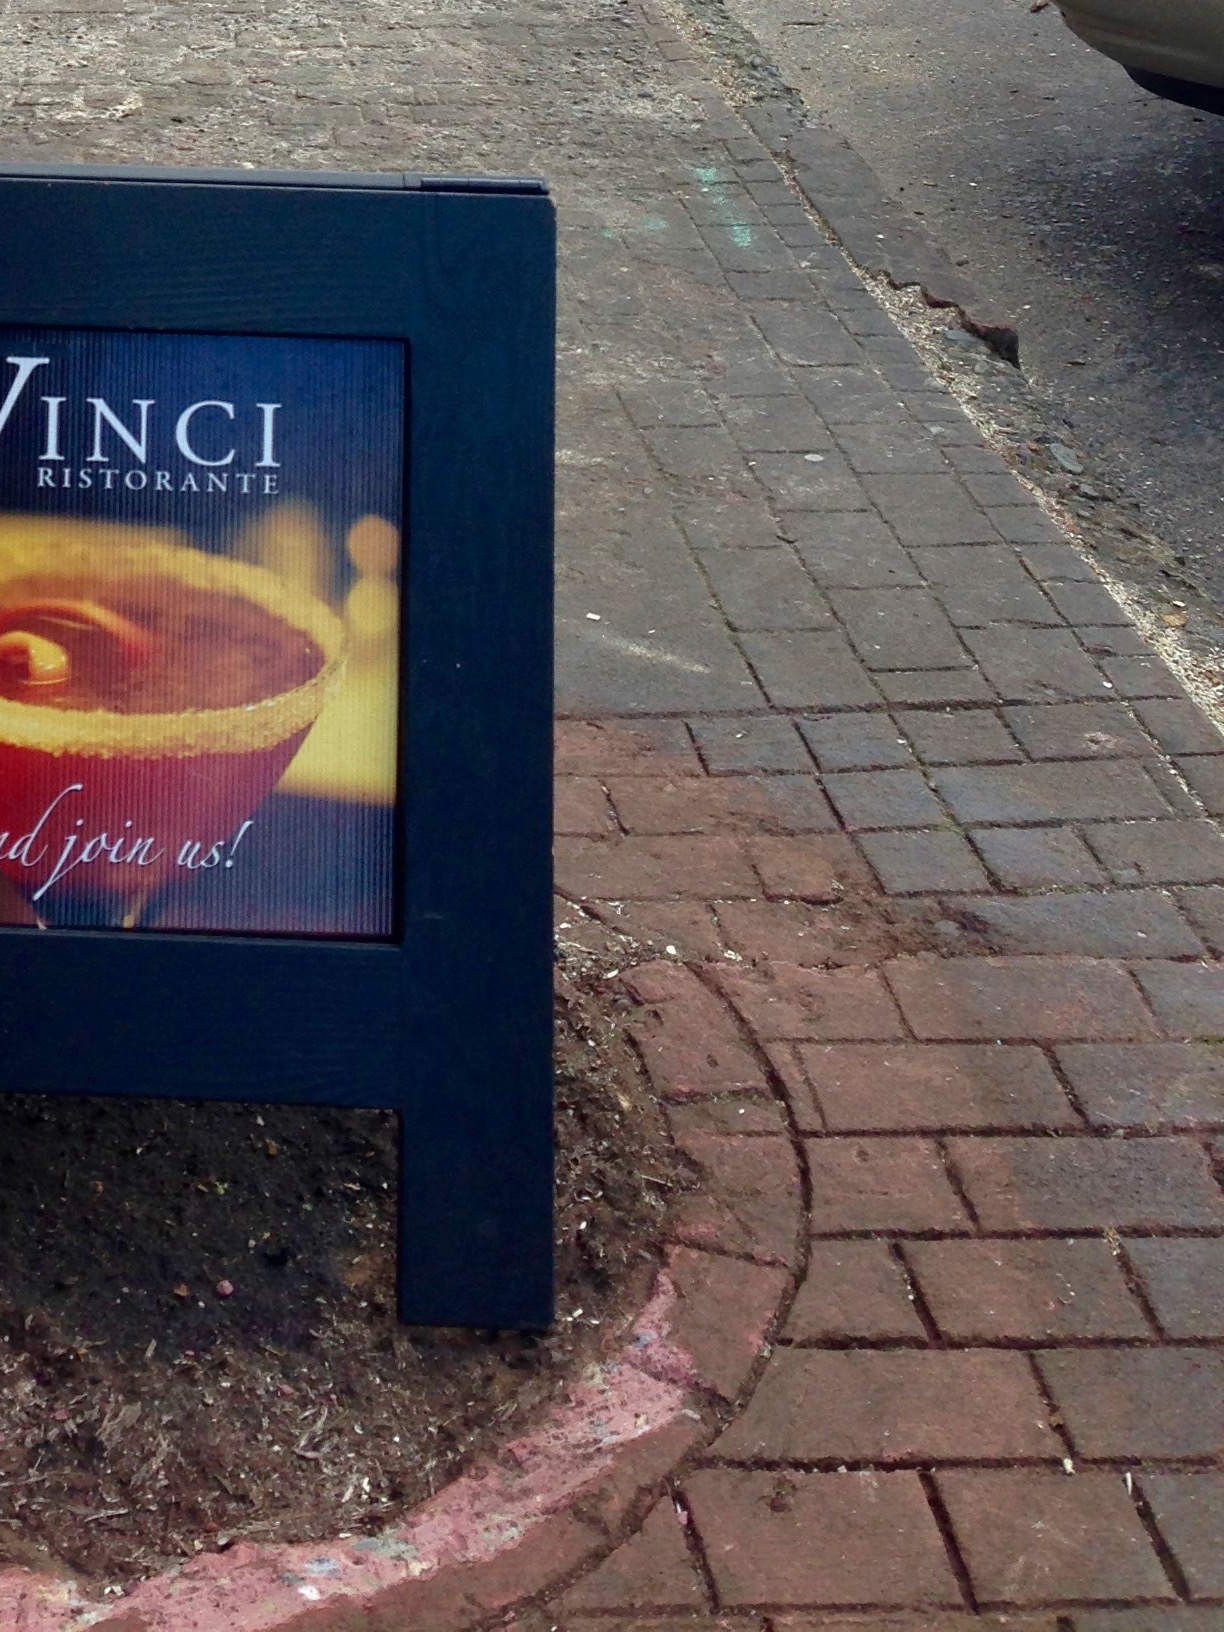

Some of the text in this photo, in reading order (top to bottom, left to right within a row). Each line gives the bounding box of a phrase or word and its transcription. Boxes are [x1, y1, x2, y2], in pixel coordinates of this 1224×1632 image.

[37, 467, 280, 496] RISTORANTE
[32, 818, 164, 901] join
[175, 820, 253, 870] us!
